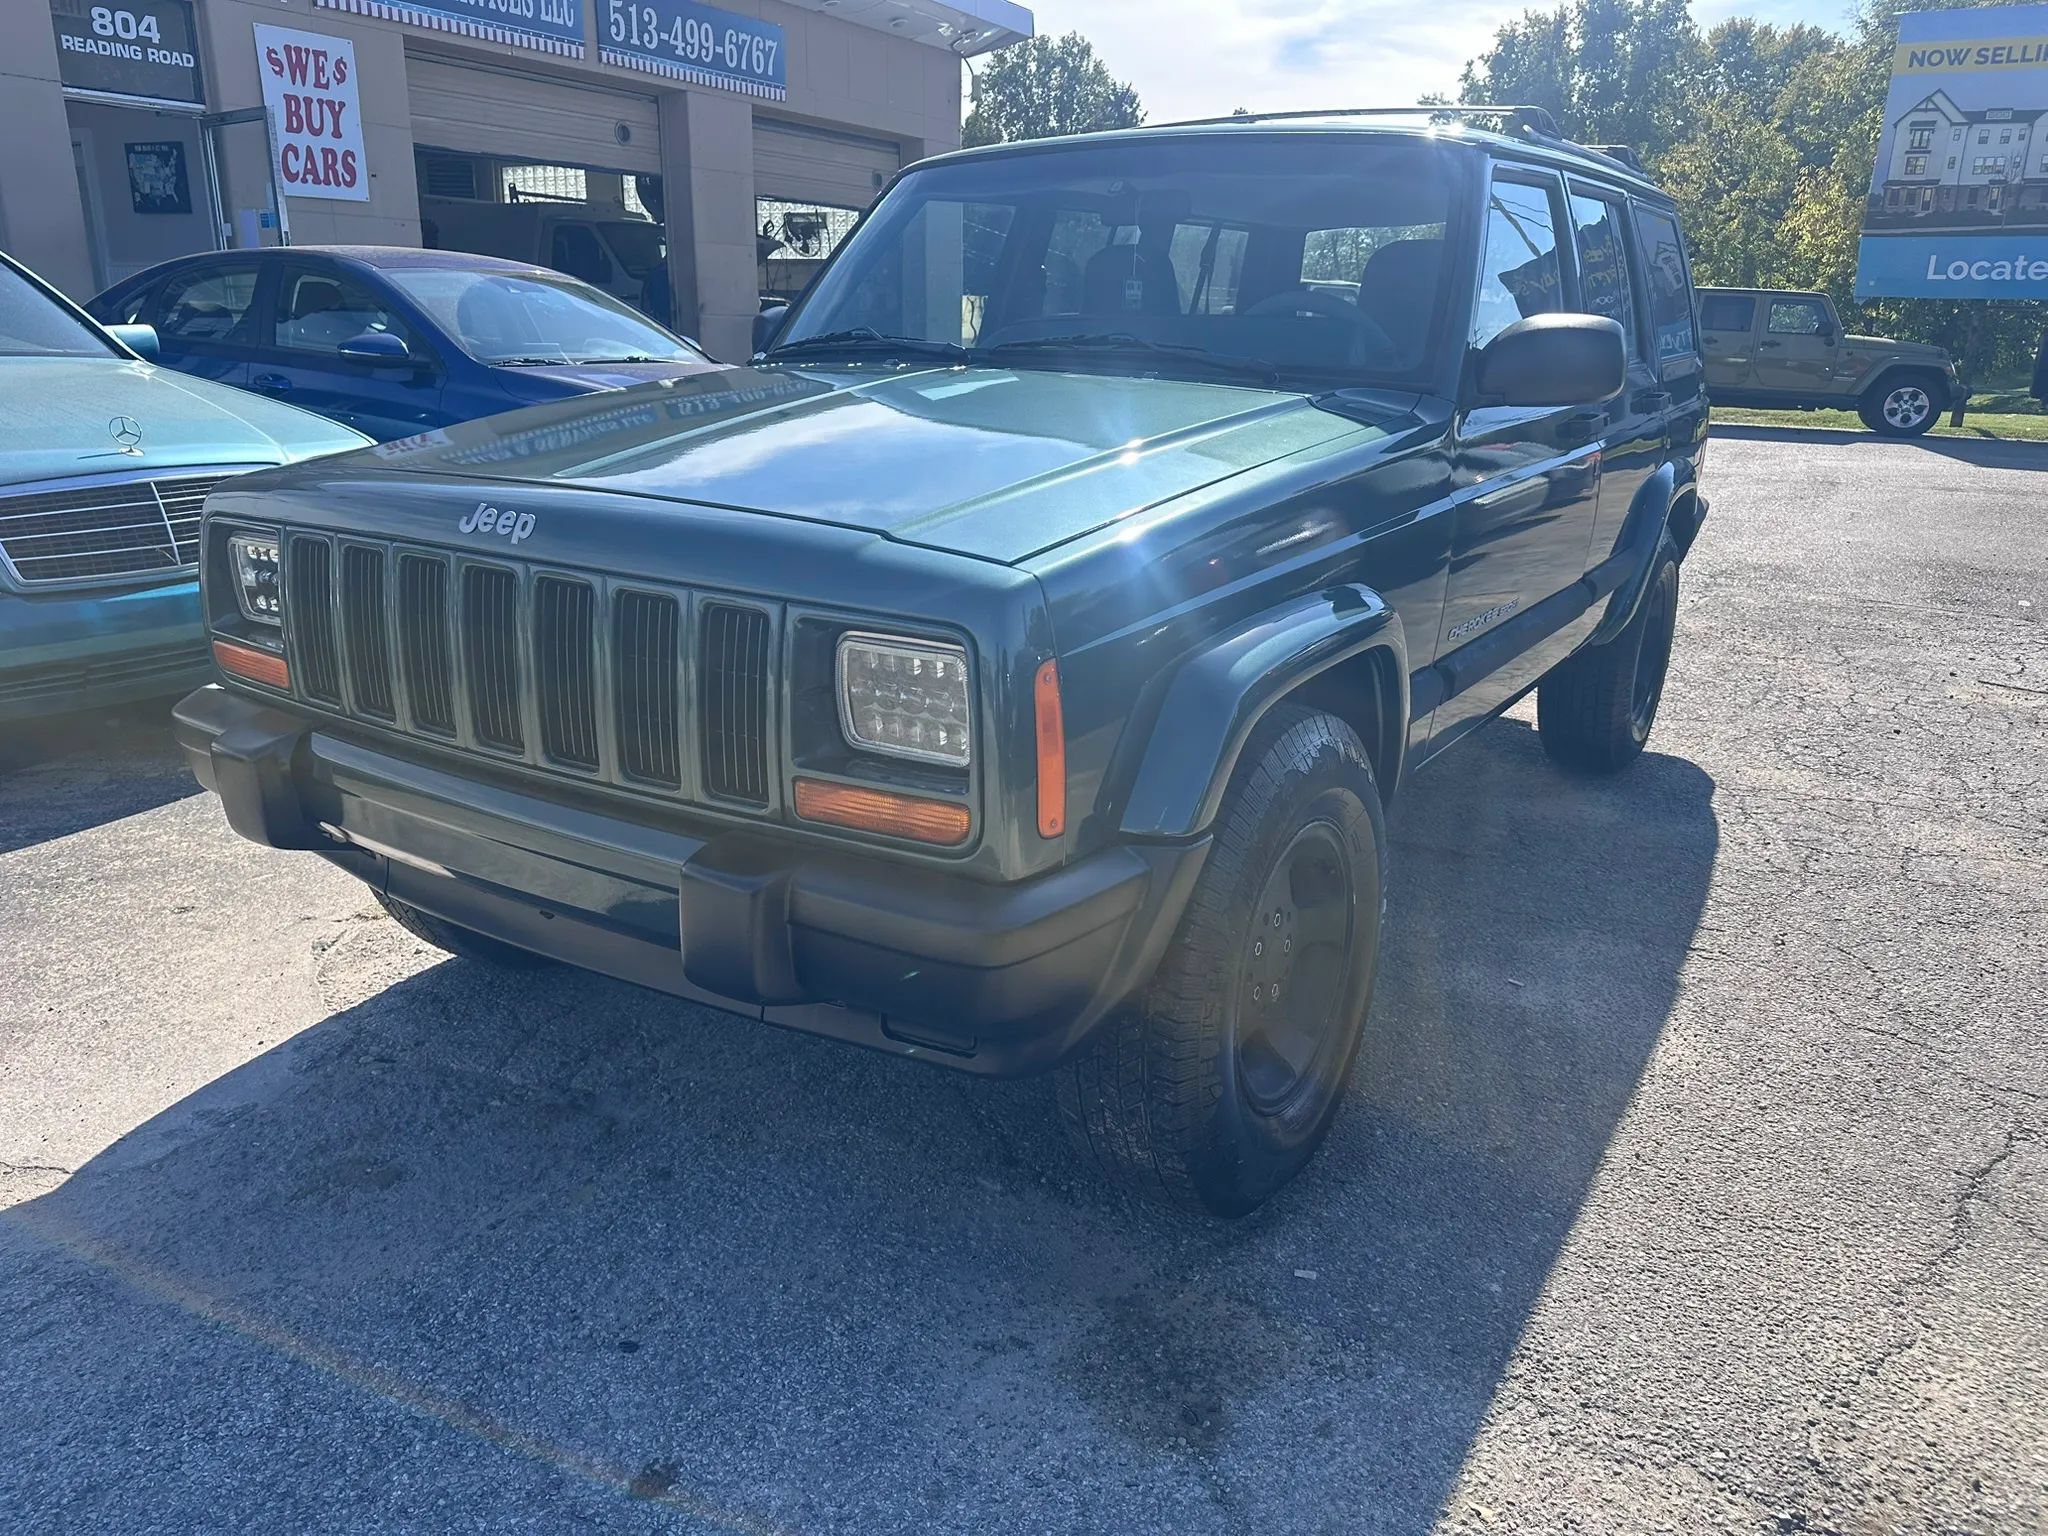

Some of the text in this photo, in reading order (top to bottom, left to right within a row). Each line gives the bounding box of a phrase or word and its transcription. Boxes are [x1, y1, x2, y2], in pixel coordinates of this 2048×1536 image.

[90, 6, 161, 44] 804
[609, 0, 778, 76] 513-499-6767
[60, 34, 195, 68] READING ROAD
[1908, 48, 1972, 68] NOW
[283, 93, 346, 139] BUY
[281, 143, 357, 188] CARS
[1927, 255, 2048, 281] Locate
[459, 503, 536, 544] Jeep
[1447, 606, 1500, 641] CHEROKEE
